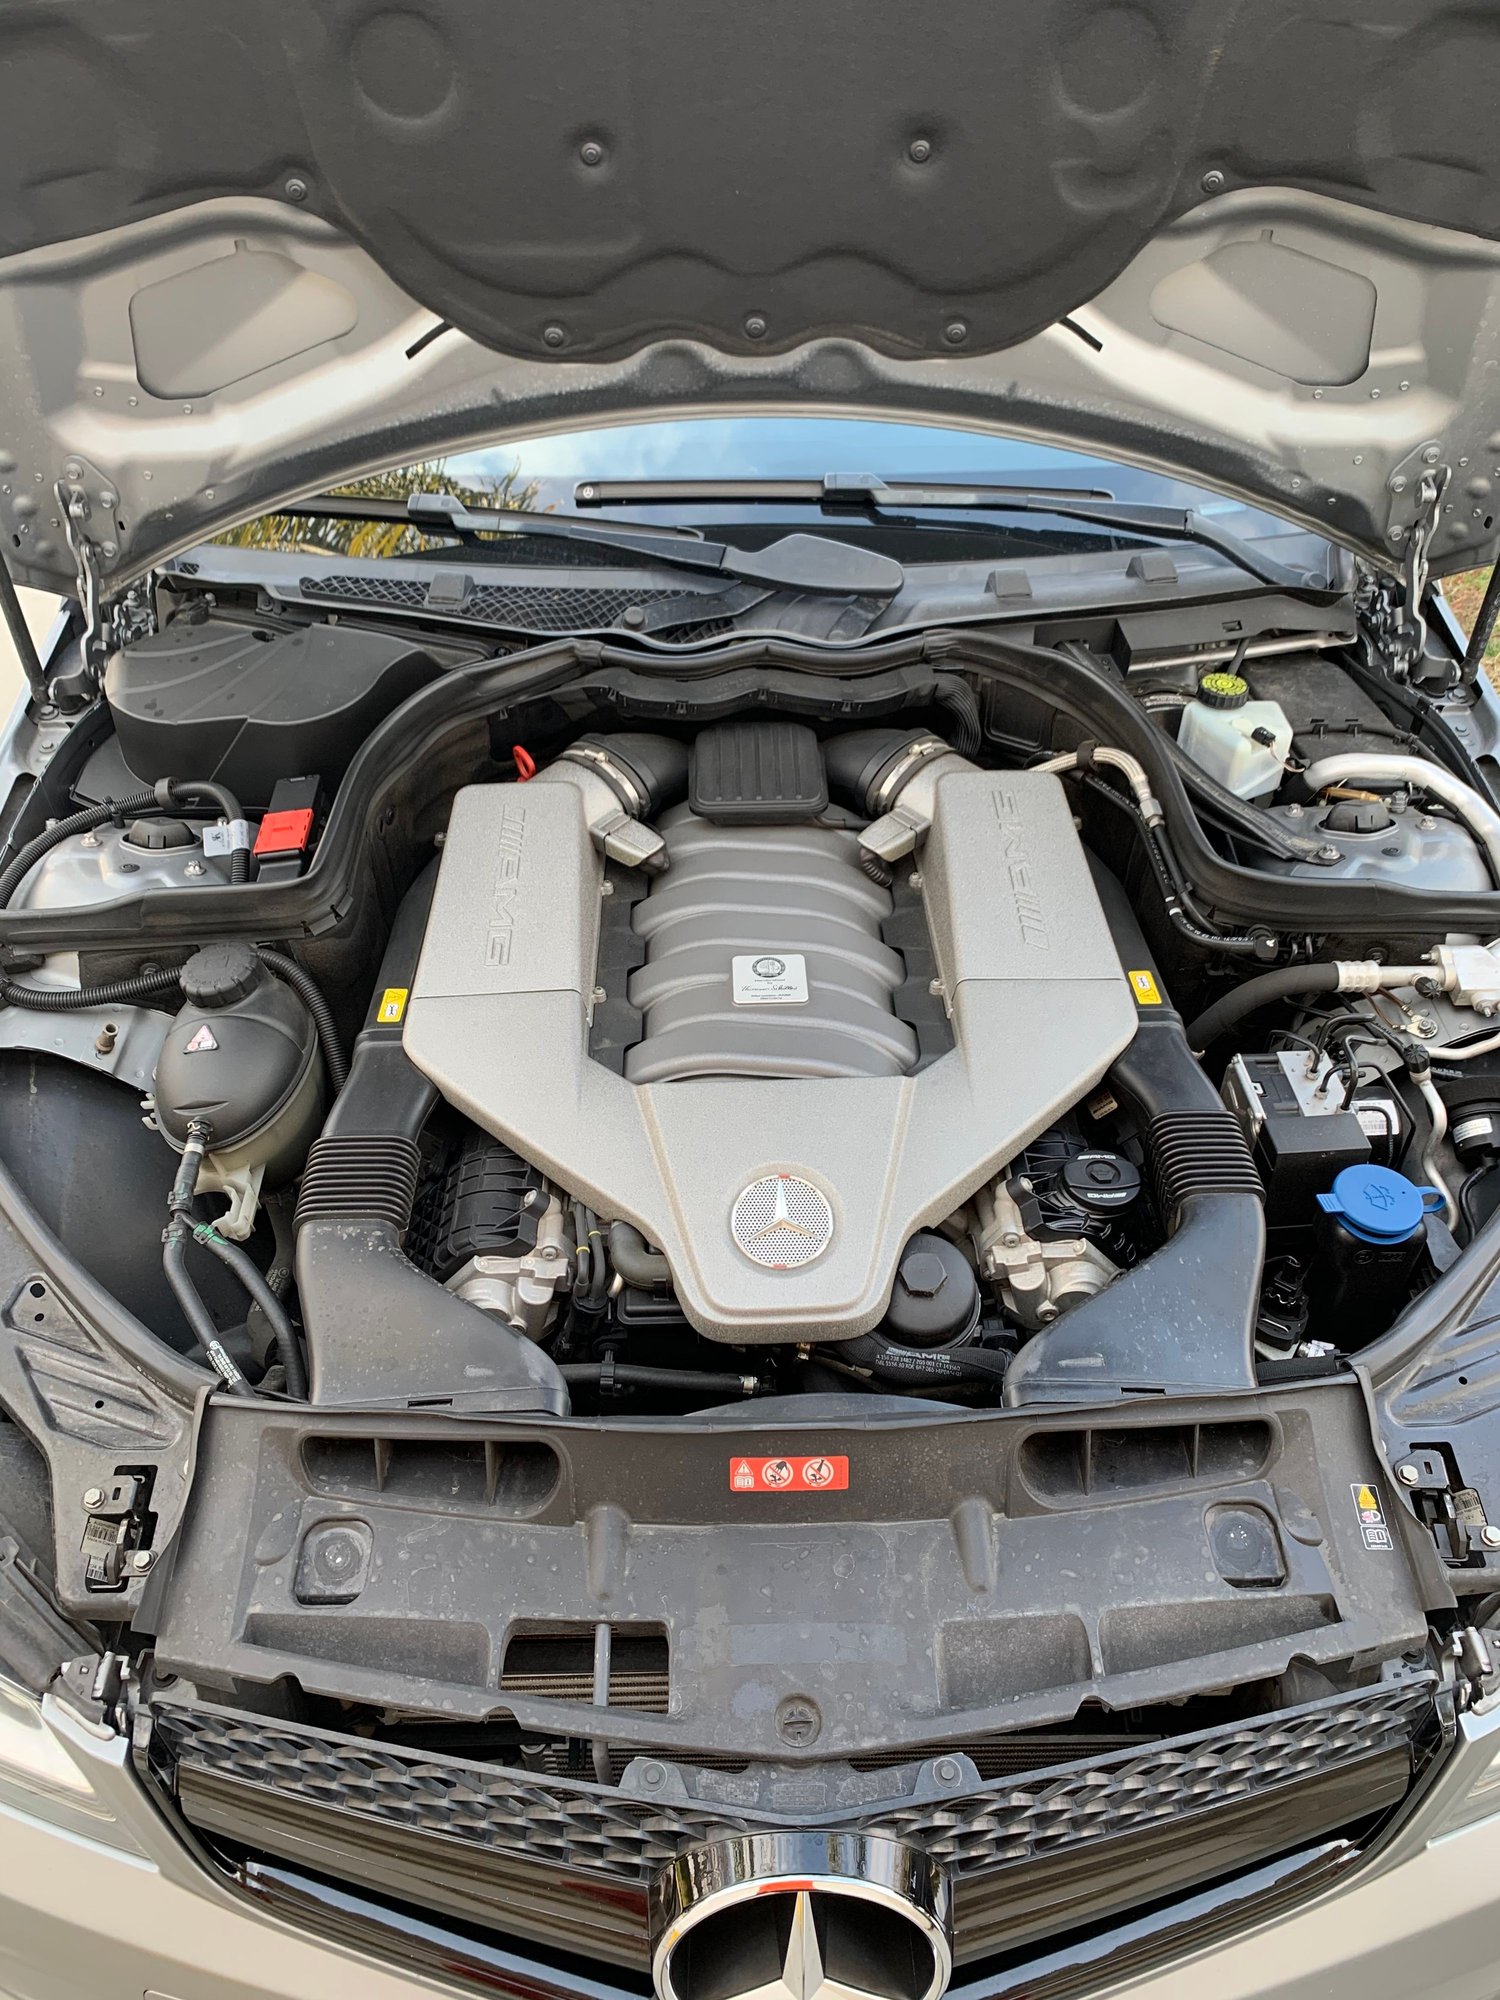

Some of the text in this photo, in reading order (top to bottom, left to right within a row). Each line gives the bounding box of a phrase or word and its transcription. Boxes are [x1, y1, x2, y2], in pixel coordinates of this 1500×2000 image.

[991, 789, 1033, 897] AMG
[483, 850, 522, 967] AMG
[904, 1350, 951, 1364] AMG
